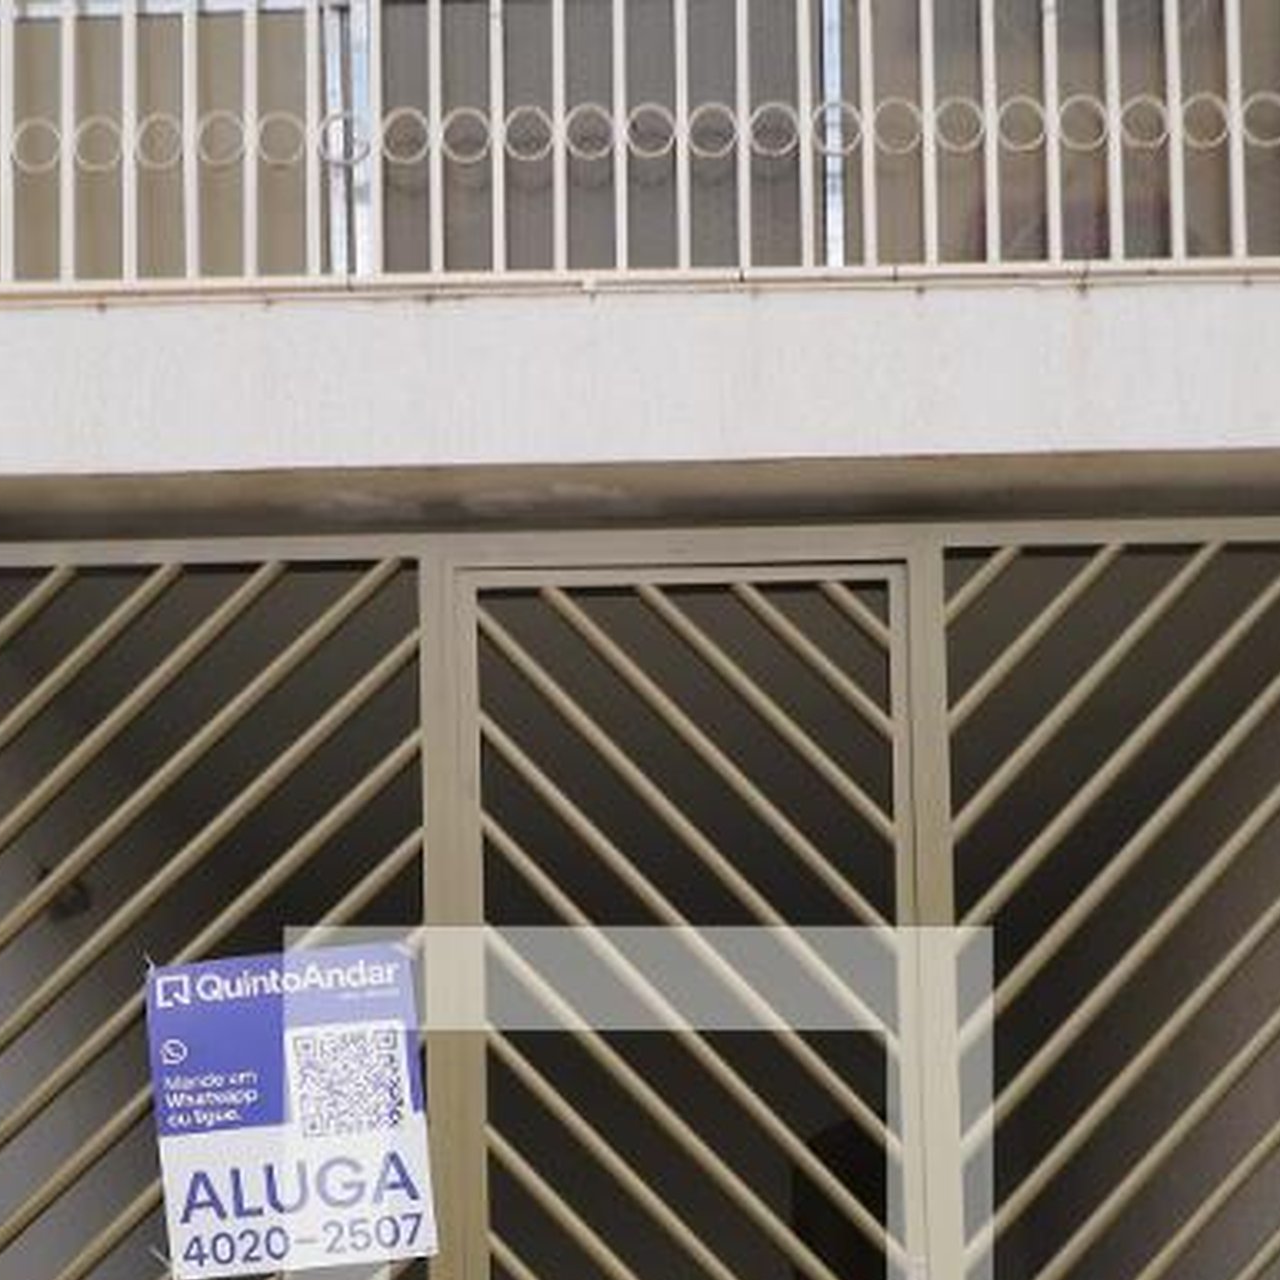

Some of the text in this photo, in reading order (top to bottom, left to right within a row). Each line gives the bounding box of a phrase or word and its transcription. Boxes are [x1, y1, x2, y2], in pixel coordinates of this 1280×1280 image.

[196, 959, 399, 1001] QuintoAndar
[180, 1151, 419, 1223] ALUGA
[183, 1212, 422, 1267] 4020-2507
